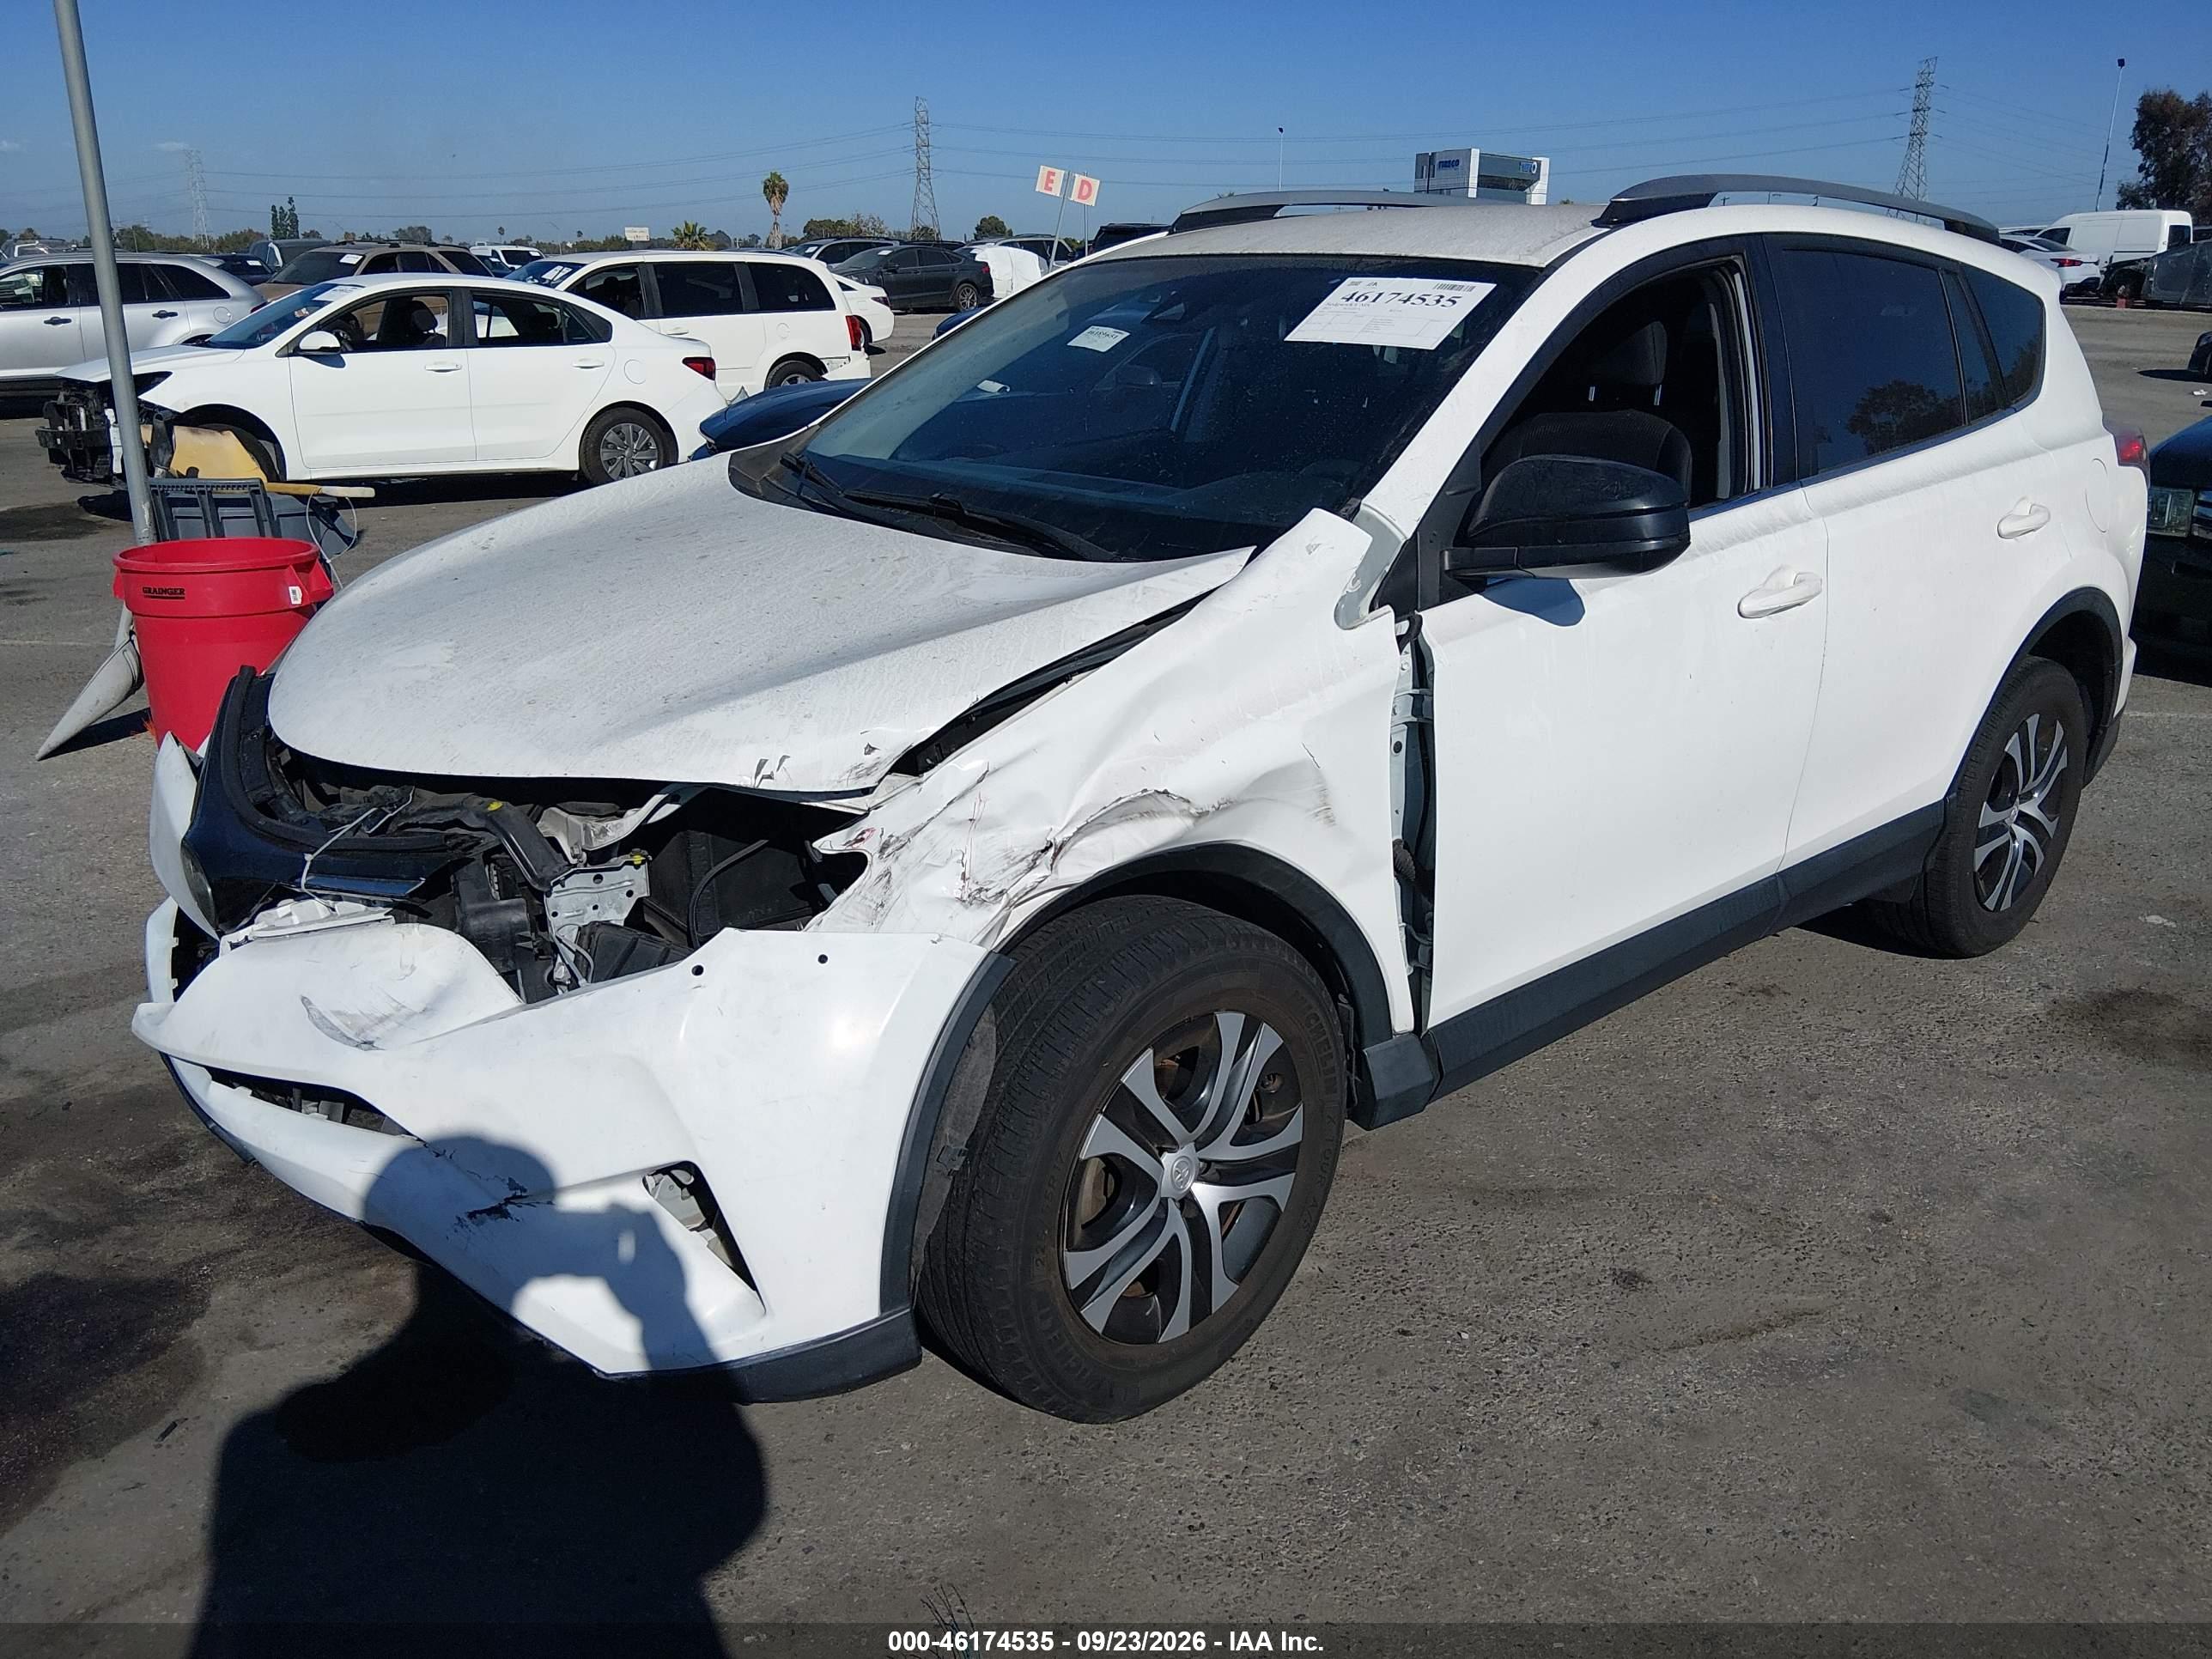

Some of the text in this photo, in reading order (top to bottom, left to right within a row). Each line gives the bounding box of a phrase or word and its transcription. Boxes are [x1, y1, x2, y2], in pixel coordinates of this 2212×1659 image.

[1043, 171, 1056, 192] E
[1077, 179, 1093, 201] D
[1340, 290, 1462, 307] 46174535
[142, 586, 185, 596] GRAINGER
